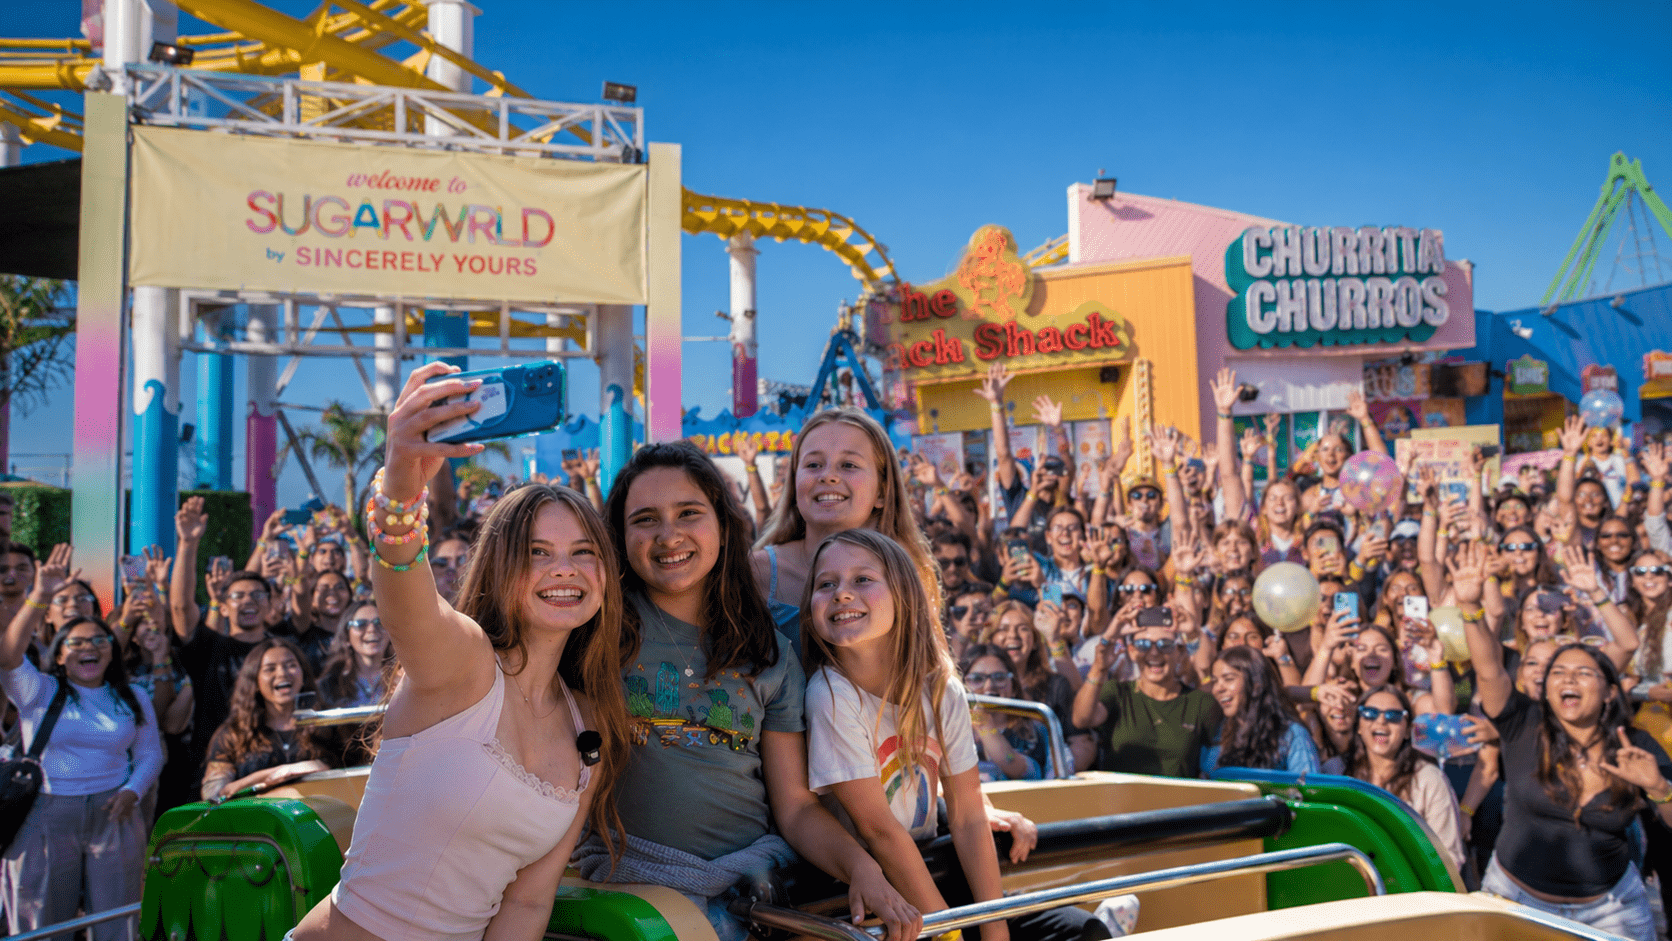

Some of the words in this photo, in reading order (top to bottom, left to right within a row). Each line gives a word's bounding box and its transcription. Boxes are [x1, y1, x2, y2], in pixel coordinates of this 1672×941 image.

[346, 170, 441, 194] welcome
[447, 175, 467, 195] to
[245, 189, 556, 249] SUGARWRLD
[266, 247, 286, 264] by
[296, 246, 443, 274] SINCERELY
[453, 253, 538, 277] YOURS
[1242, 225, 1446, 278] CHURRITA
[1245, 275, 1450, 335] CHURROS
[886, 328, 965, 370] ack
[974, 311, 1122, 361] Shack
